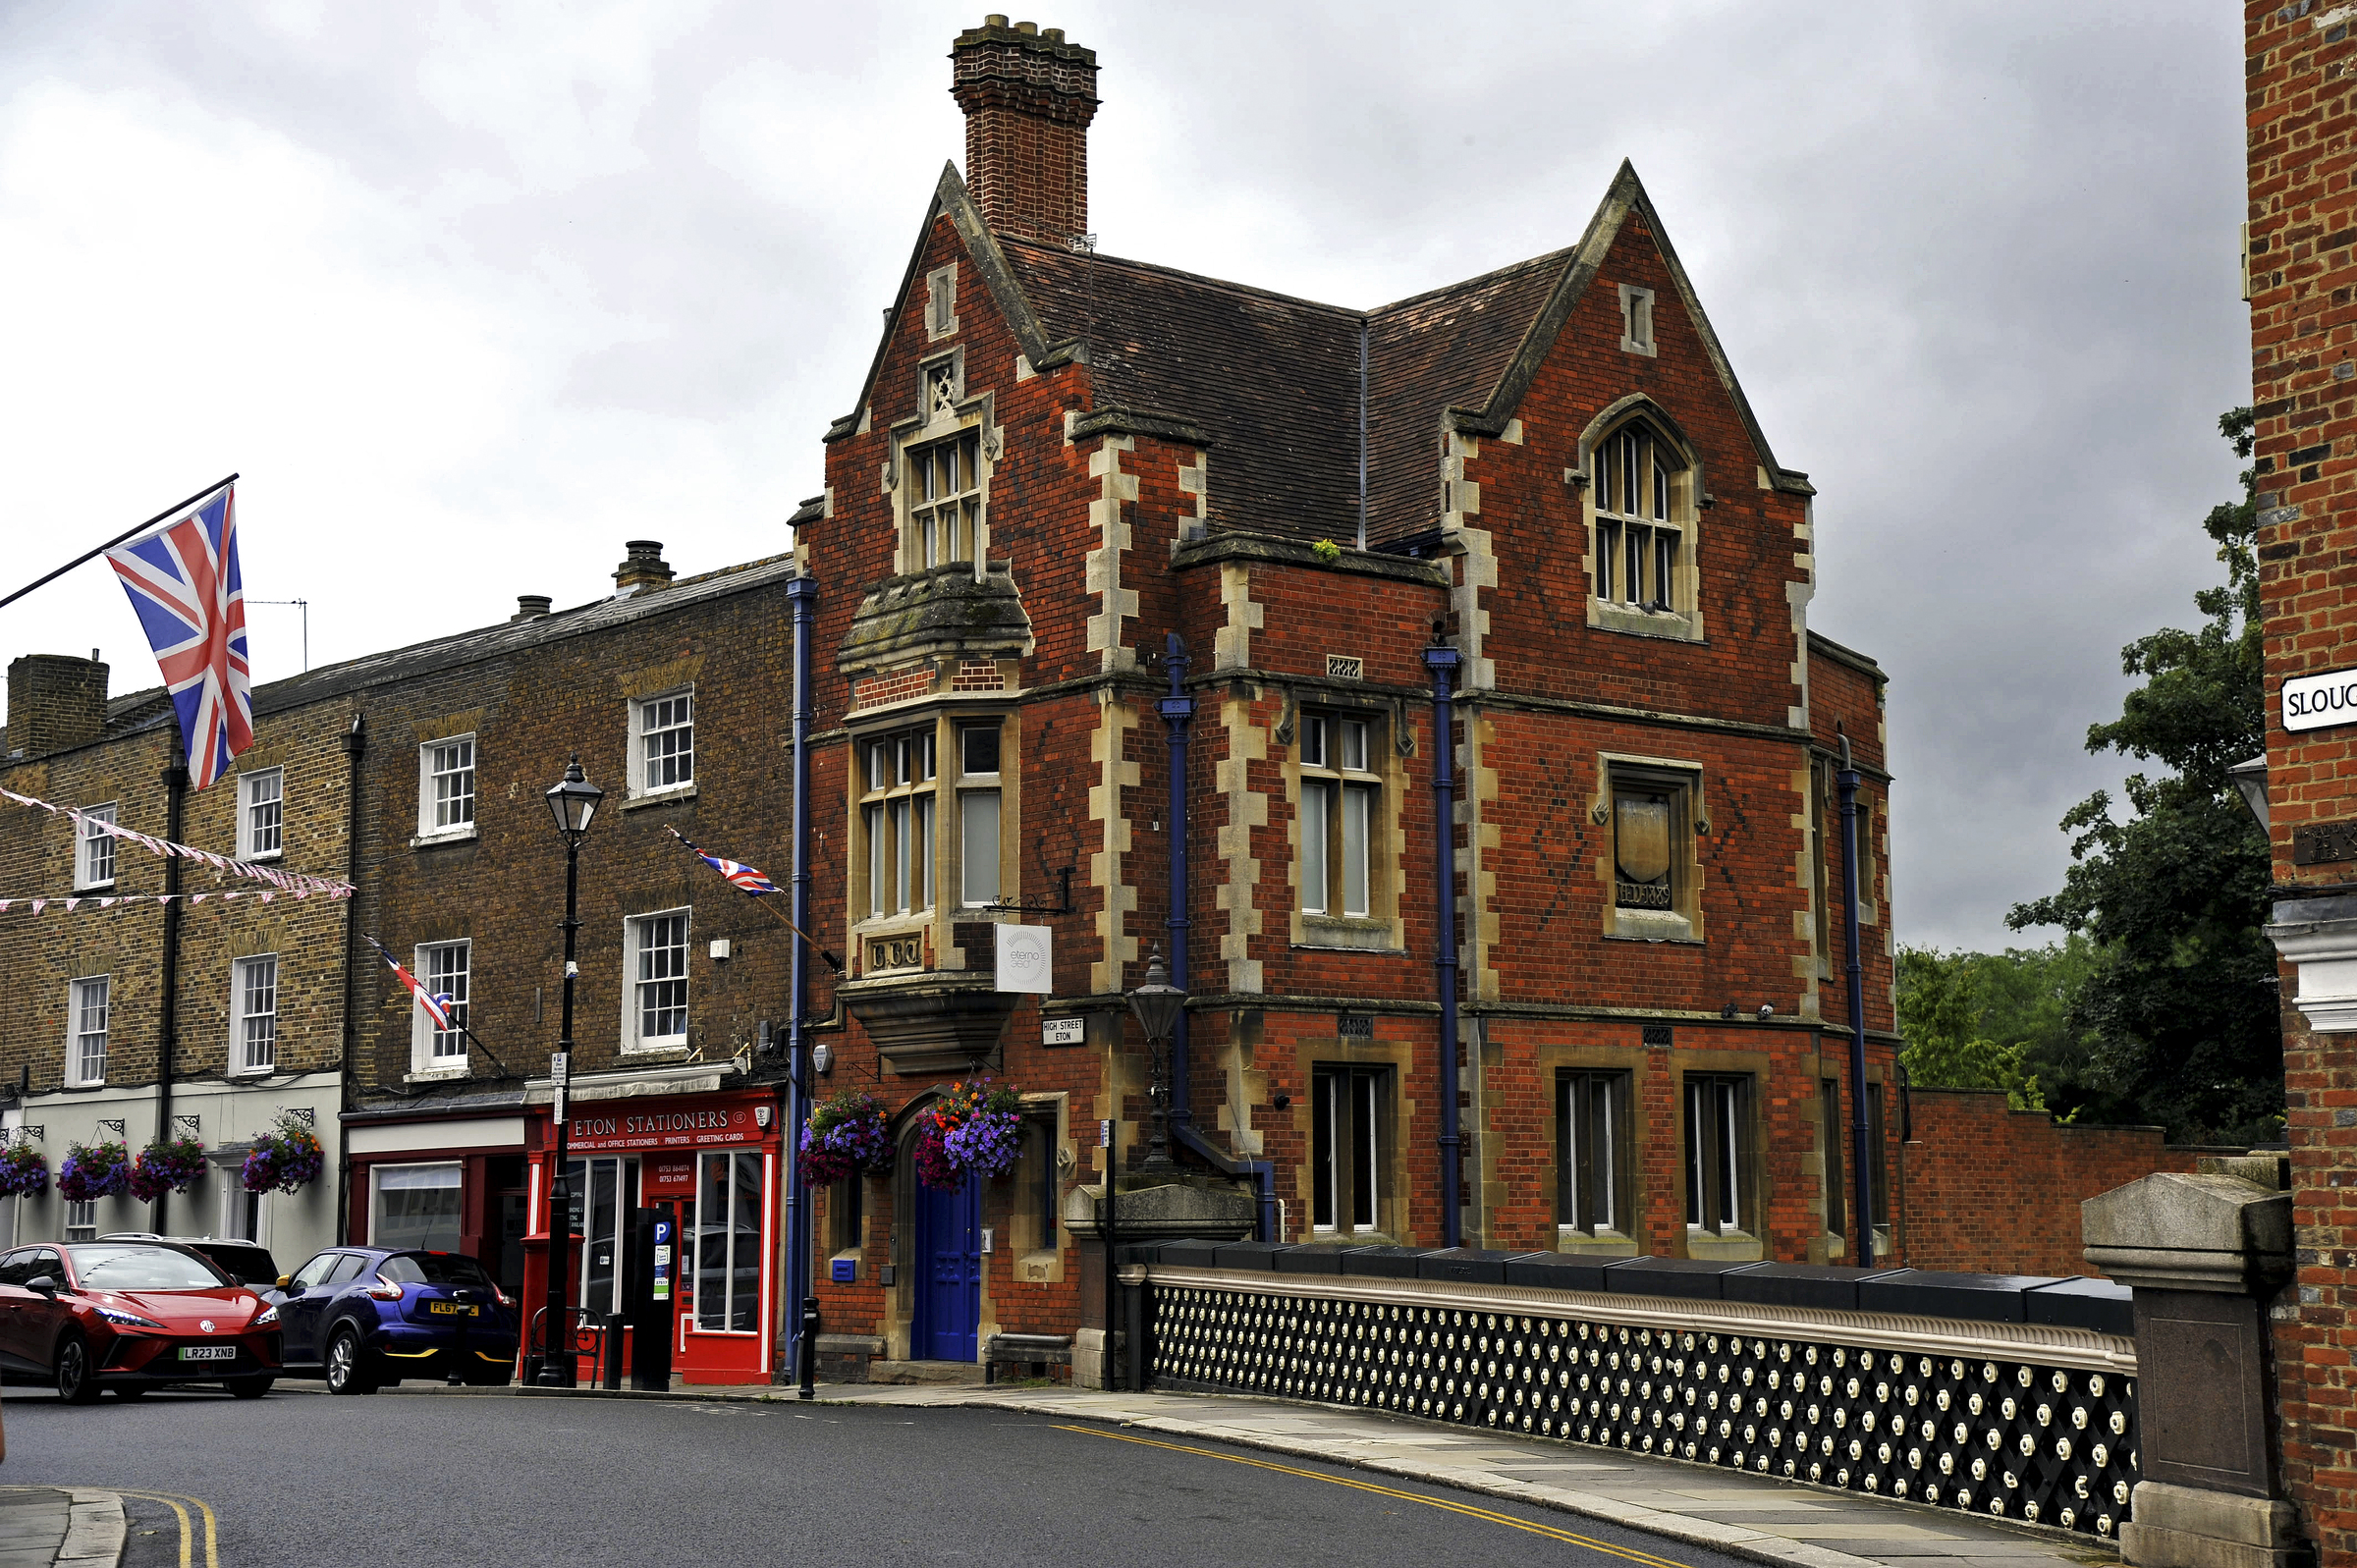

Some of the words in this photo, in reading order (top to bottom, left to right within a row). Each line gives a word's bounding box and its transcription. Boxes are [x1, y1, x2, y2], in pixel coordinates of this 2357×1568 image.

[2309, 848, 2339, 863] MILES
[1011, 950, 1039, 960] eterno
[1043, 1022, 1058, 1032] HIGH
[1060, 1019, 1082, 1030] STREET
[1055, 1032, 1071, 1042] ETON
[575, 1118, 616, 1137] ETON
[627, 1110, 728, 1133] STATIONERS
[567, 1141, 595, 1150] OMMERCIAL
[627, 1138, 658, 1147] STATIONERS
[665, 1136, 689, 1145] PRINTERS
[696, 1134, 724, 1143] GREETING
[725, 1132, 743, 1142] CARDS
[656, 1223, 667, 1240] P
[433, 1303, 457, 1313] FL67
[185, 1348, 212, 1359] LR23
[214, 1347, 235, 1358] XNB
